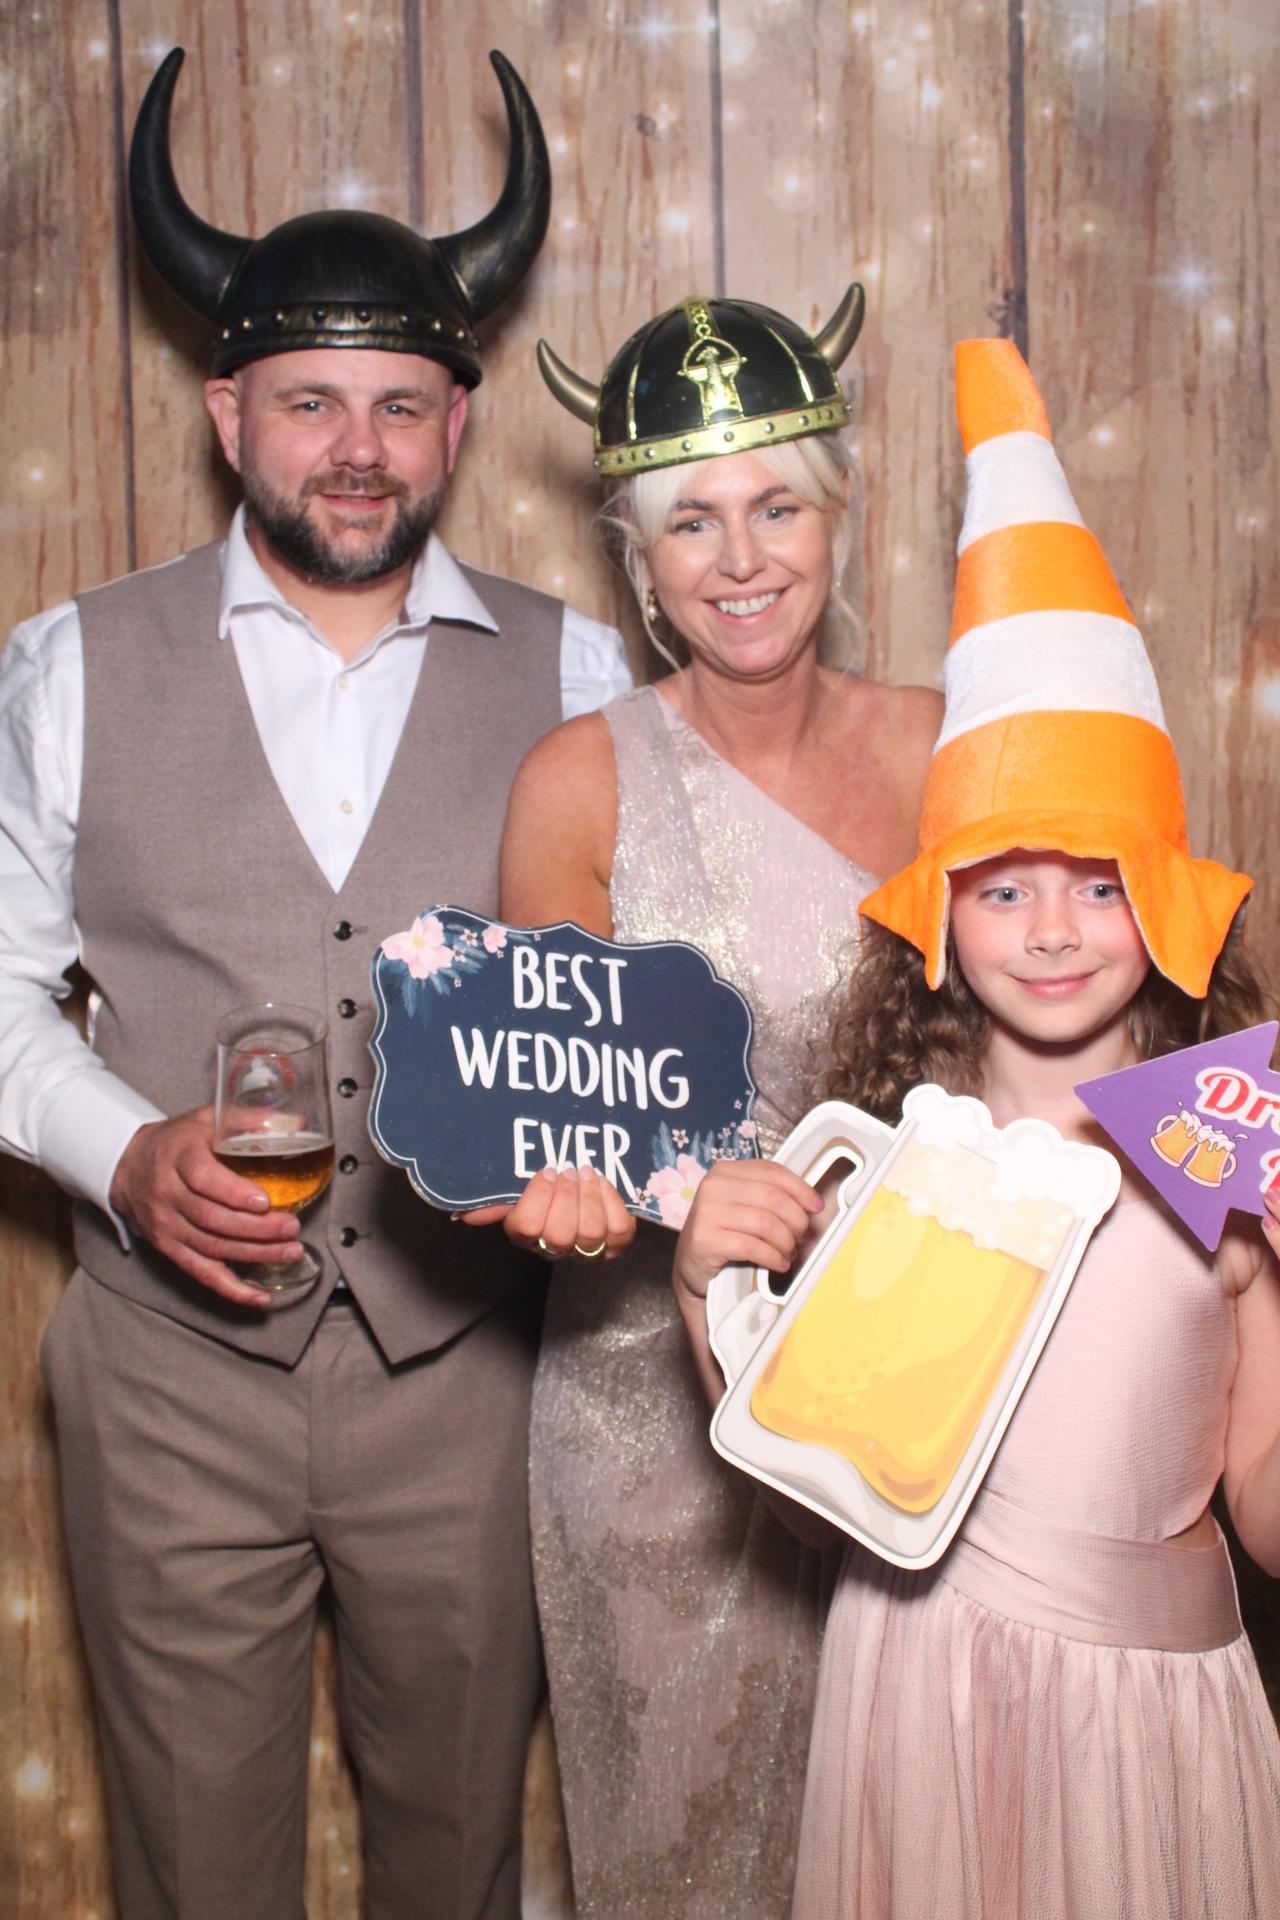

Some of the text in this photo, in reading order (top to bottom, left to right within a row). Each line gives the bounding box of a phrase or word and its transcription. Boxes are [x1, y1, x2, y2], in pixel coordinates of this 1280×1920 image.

[512, 945, 628, 1026] BEST
[450, 1025, 690, 1110] WEDDING
[1203, 1072, 1280, 1128] Dr
[513, 1117, 639, 1204] EVER
